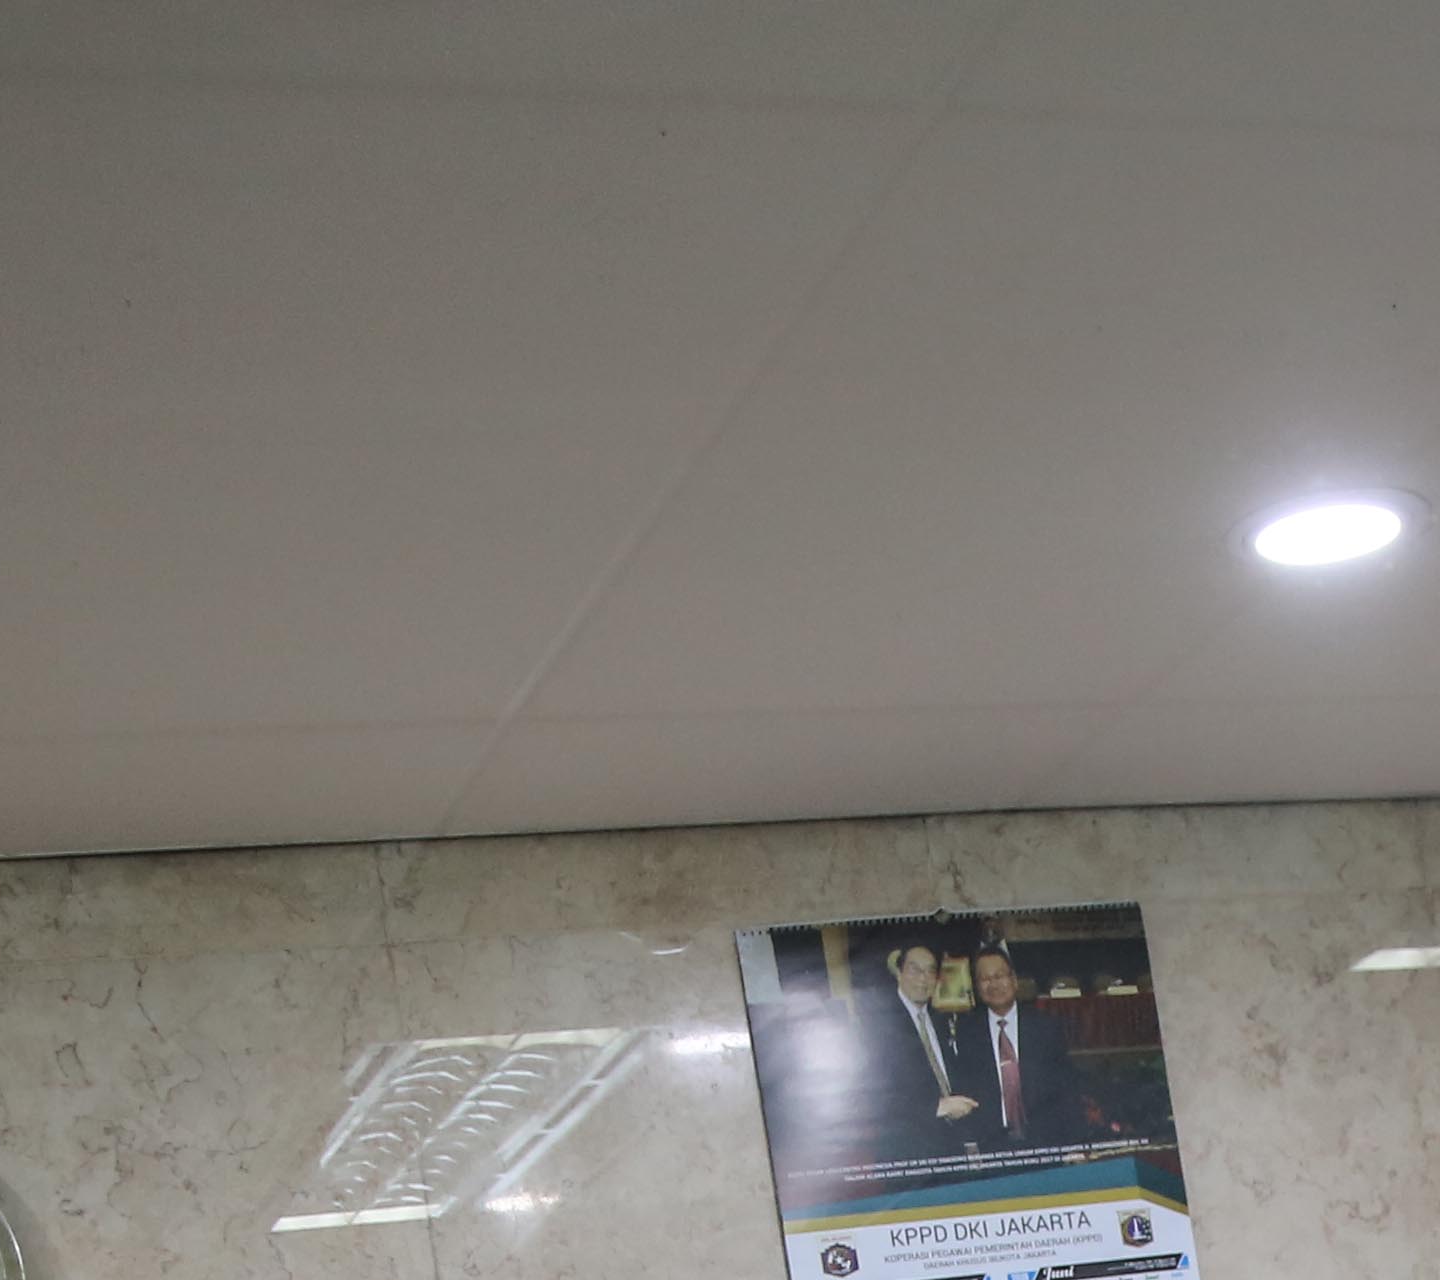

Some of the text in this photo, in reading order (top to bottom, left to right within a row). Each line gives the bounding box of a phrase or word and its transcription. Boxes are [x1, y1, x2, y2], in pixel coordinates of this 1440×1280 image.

[890, 1211, 1091, 1247] KPPD DKI JAKARTA
